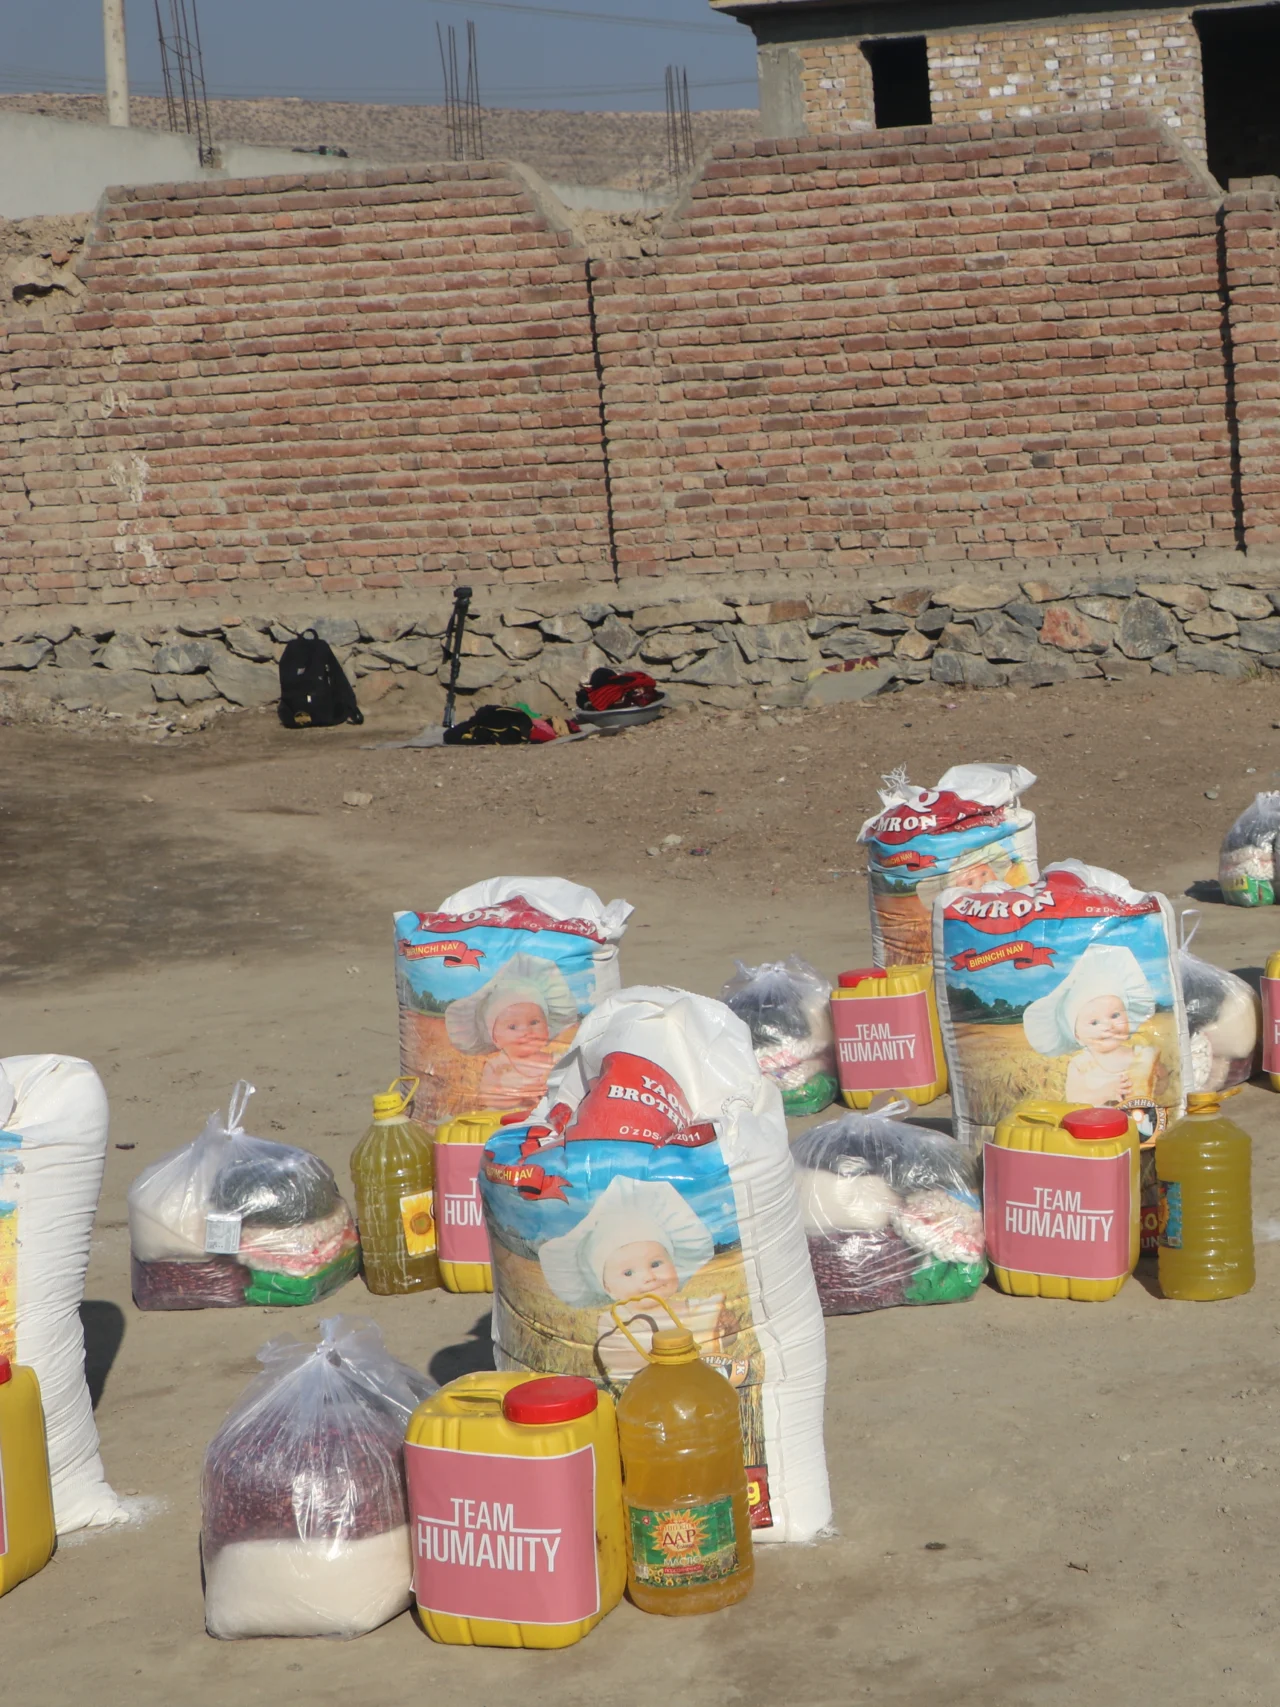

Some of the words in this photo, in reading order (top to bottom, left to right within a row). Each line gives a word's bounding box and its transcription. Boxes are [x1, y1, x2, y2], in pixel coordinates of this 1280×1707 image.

[953, 890, 1057, 919] EMRON
[441, 943, 459, 954] NAV
[968, 947, 1005, 968] BIRINCHI
[1005, 943, 1024, 957] NAV
[856, 1023, 890, 1040] TEAM
[839, 1039, 916, 1063] HUMANITY
[1033, 1187, 1082, 1212] TEAM
[1005, 1207, 1113, 1242] HUMANITY
[450, 1498, 515, 1532] TEAM
[417, 1523, 561, 1573] HUMANITY
[663, 1530, 696, 1547] ДАР
